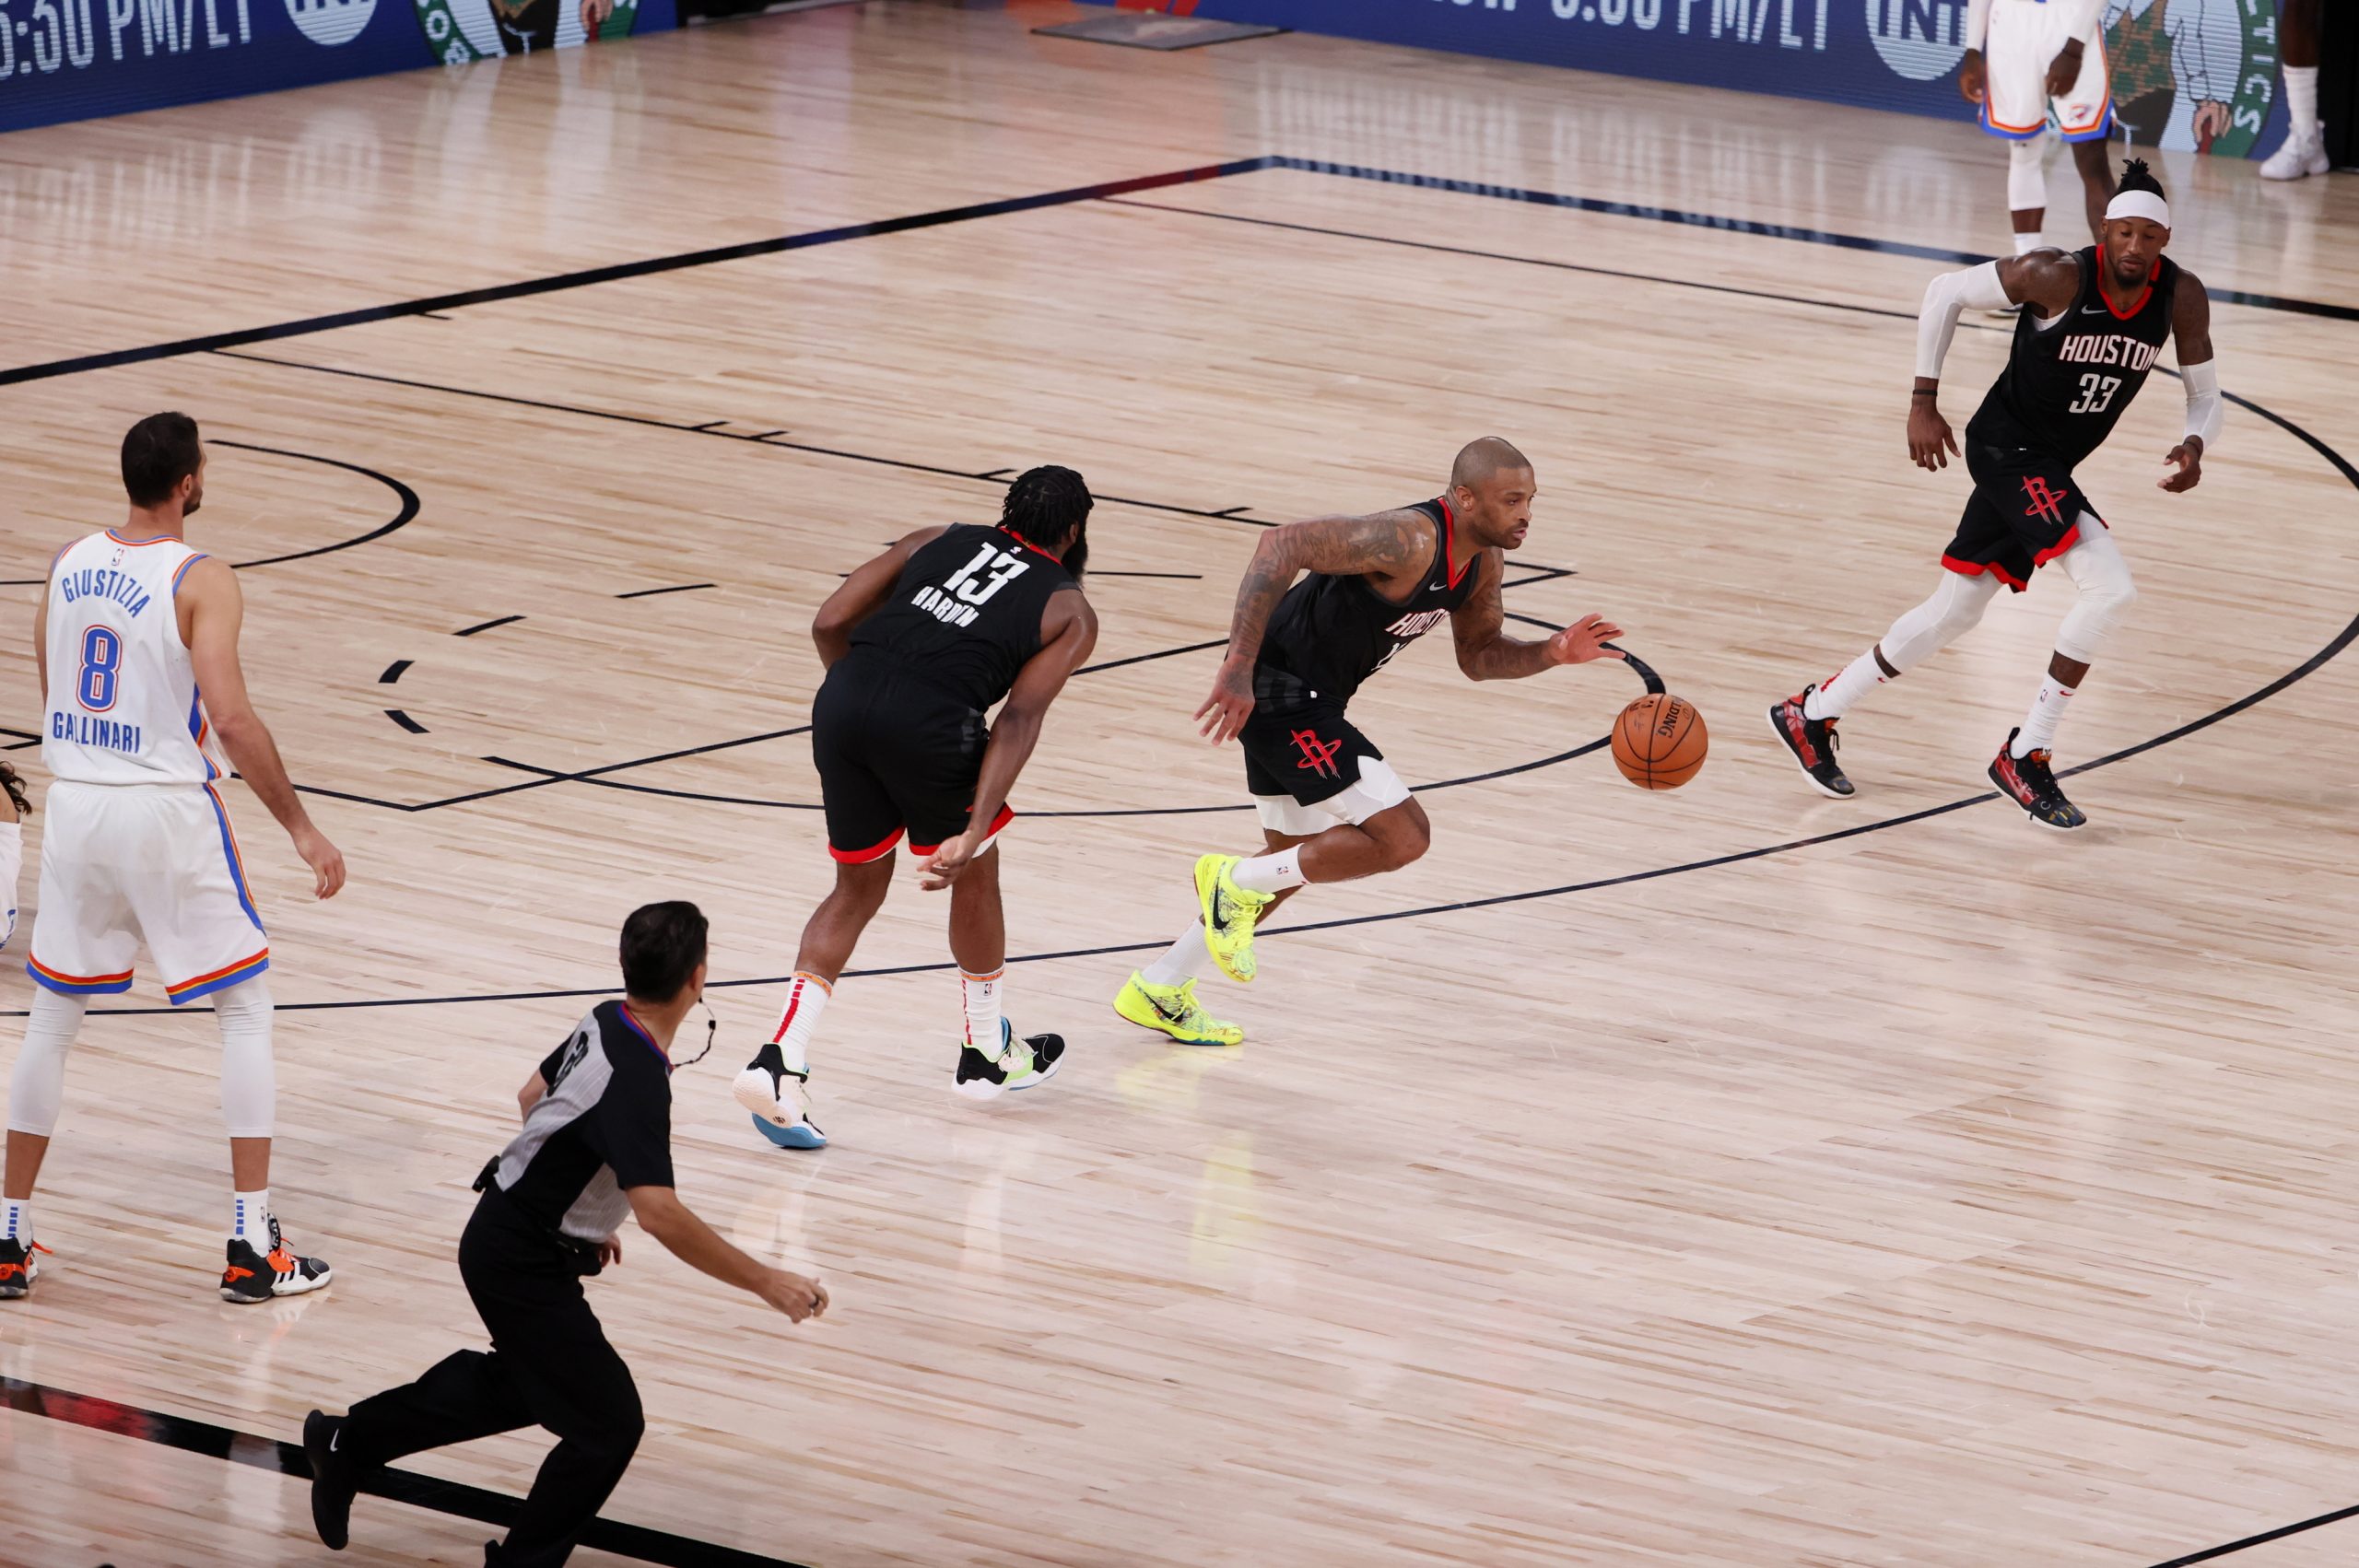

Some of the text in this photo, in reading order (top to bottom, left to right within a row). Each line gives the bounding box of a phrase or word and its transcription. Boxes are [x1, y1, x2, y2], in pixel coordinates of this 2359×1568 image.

[2059, 333, 2161, 371] HOUSTON
[2068, 372, 2122, 414] 33
[62, 568, 151, 618] GIUSTIZIA
[943, 541, 1030, 606] 13
[76, 624, 123, 713] 8
